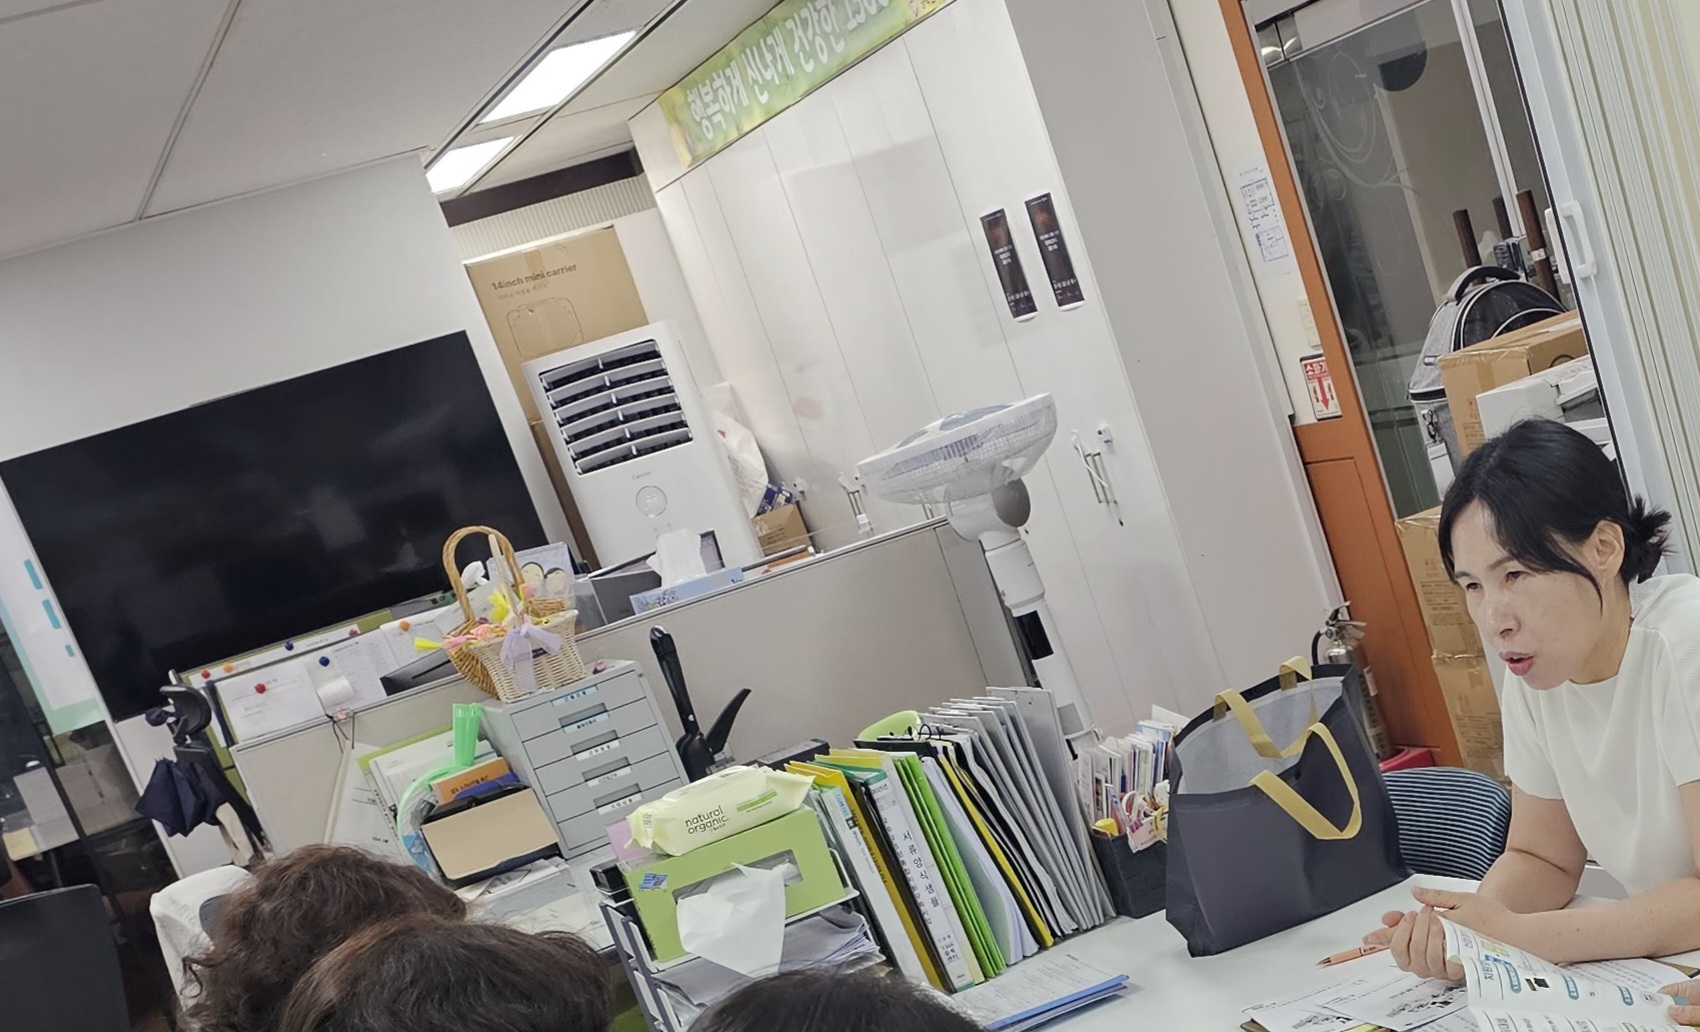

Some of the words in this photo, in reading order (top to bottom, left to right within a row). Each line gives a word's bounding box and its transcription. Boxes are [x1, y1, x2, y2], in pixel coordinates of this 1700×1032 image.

[686, 60, 749, 140] 행복하게
[744, 26, 795, 104] 신나게
[785, 0, 846, 73] 건강한
[491, 276, 524, 290] 14inch
[525, 270, 545, 283] mini
[546, 264, 577, 277] carrier
[685, 804, 724, 827] natural
[688, 815, 728, 835] organic
